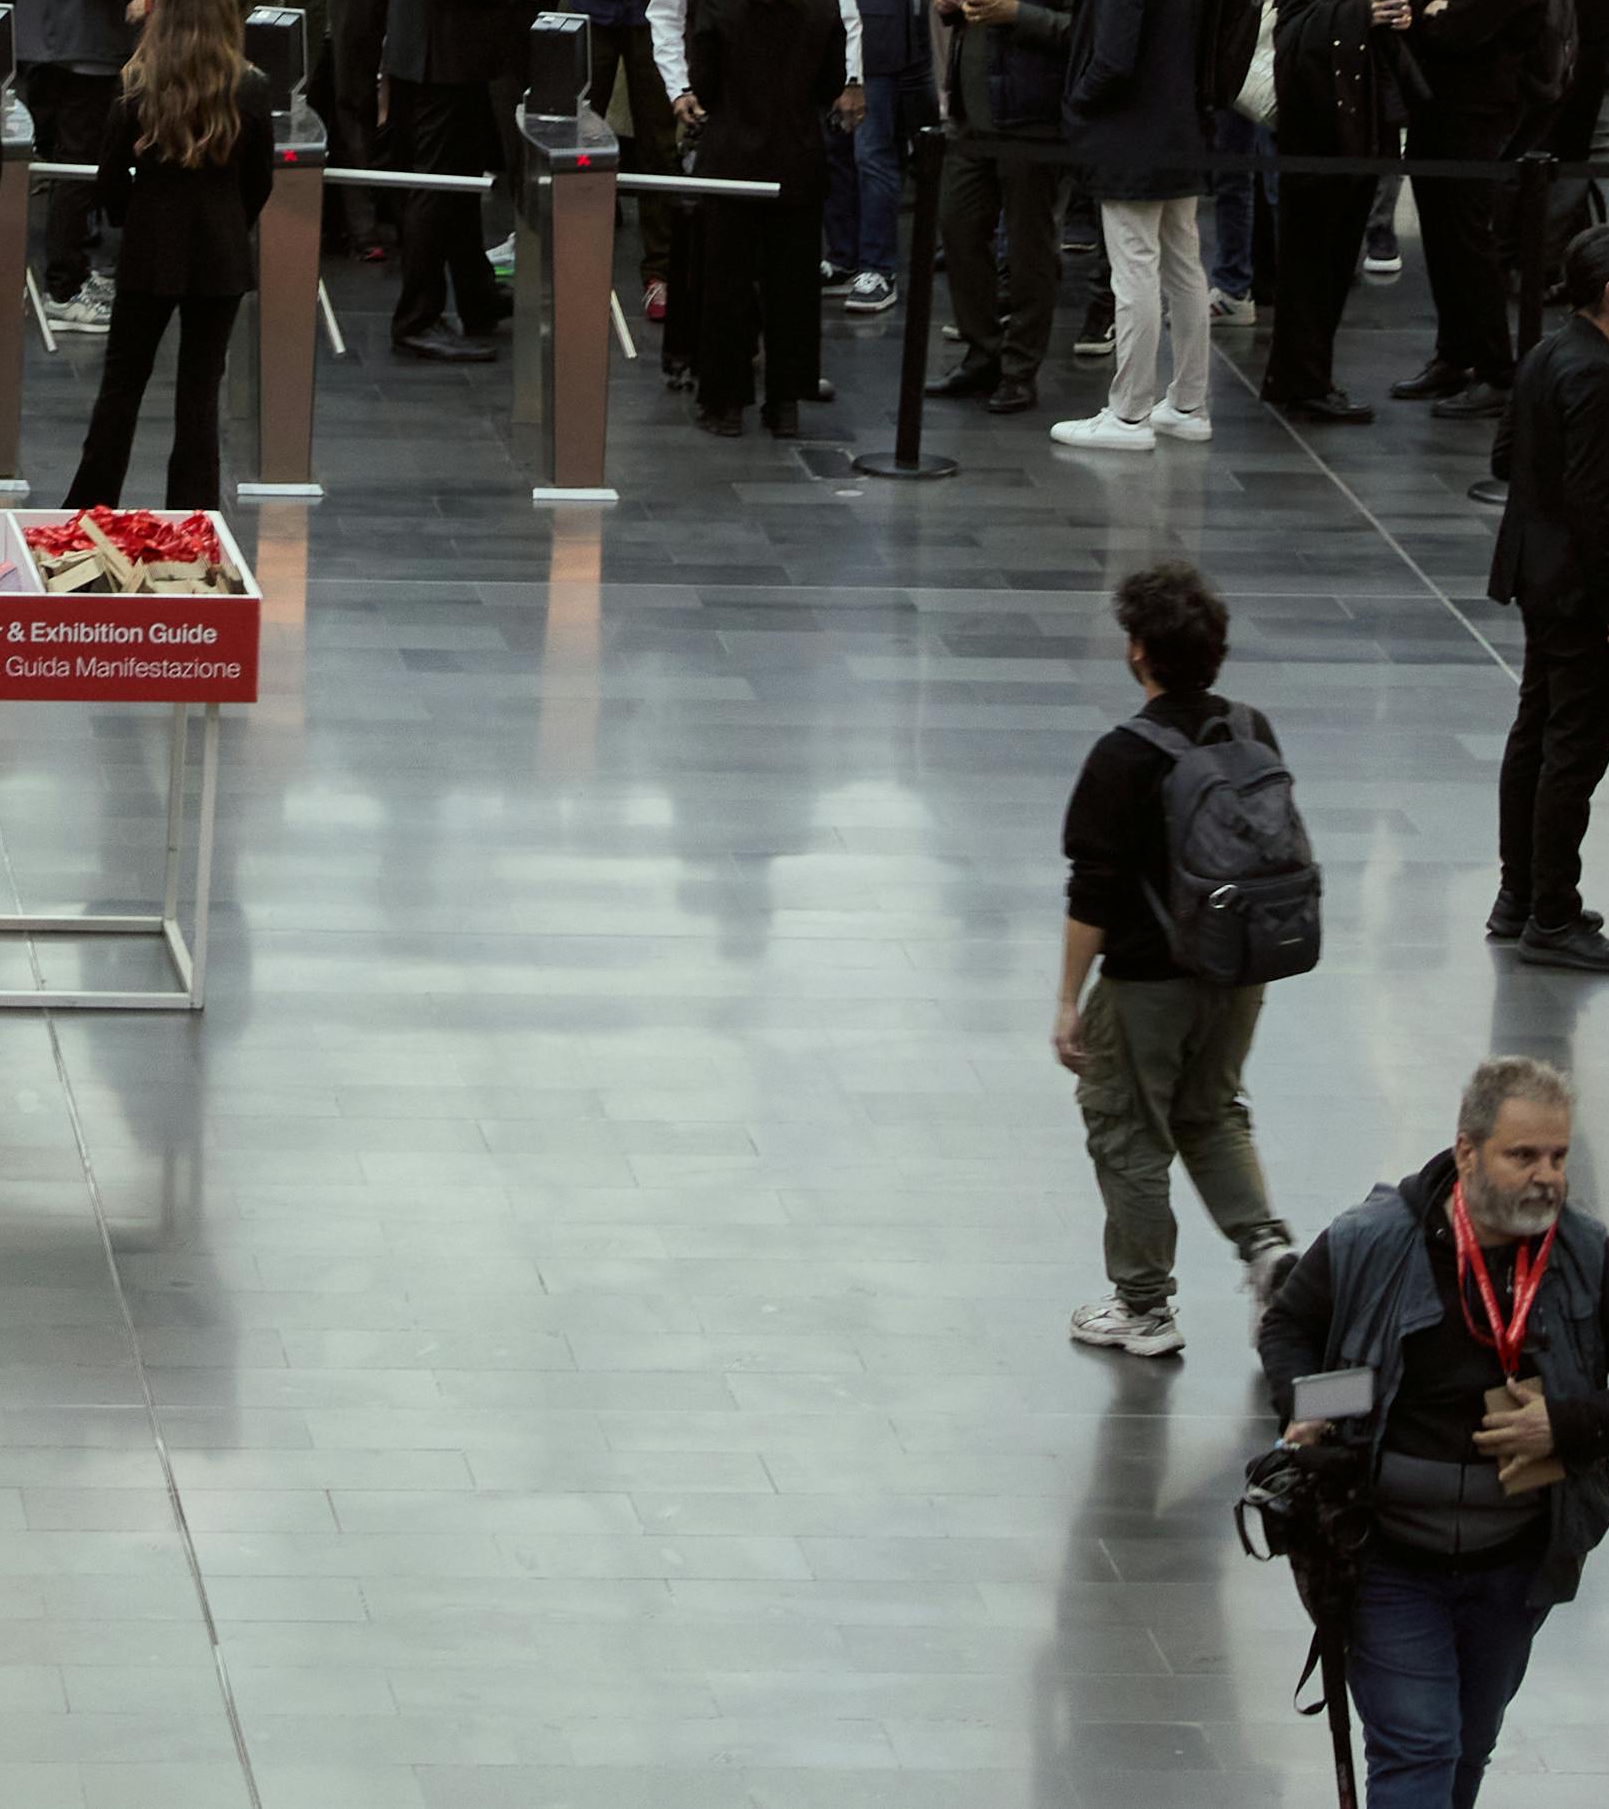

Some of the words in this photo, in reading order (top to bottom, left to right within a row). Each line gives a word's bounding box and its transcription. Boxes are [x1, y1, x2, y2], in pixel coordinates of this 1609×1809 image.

[7, 622, 26, 643] &
[30, 622, 143, 643] Exhibition
[149, 623, 218, 644] Guide
[6, 656, 70, 678] Guida
[76, 656, 241, 679] Manifestazione
